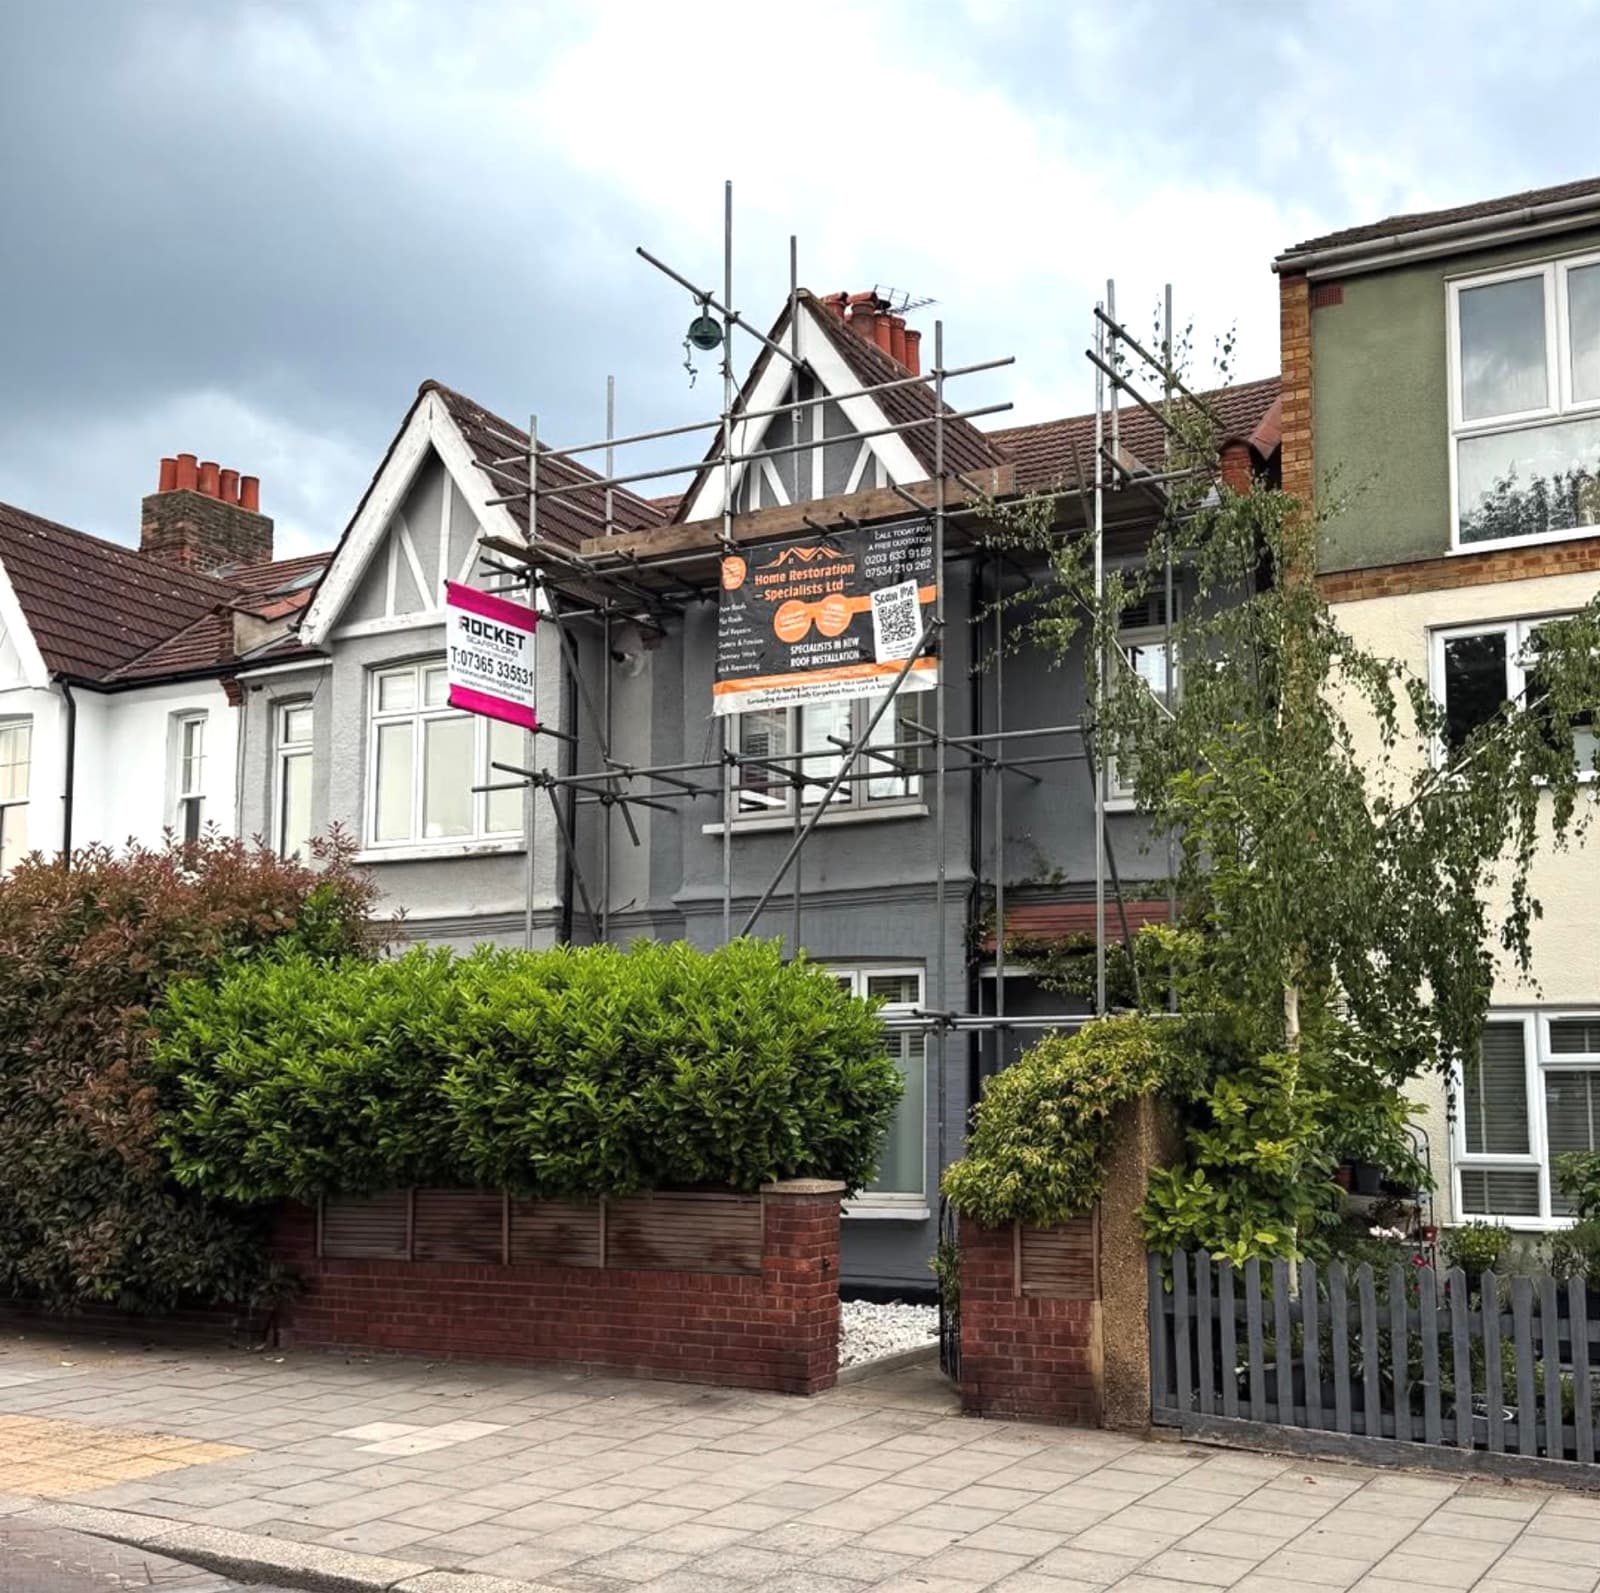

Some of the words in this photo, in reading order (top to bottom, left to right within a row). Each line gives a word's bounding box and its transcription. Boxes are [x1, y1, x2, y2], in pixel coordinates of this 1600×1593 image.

[893, 527, 915, 536] TODAY
[916, 525, 932, 533] FOR
[875, 541, 891, 549] FREE
[892, 535, 932, 547] QUOTATION
[864, 553, 887, 565] 0203
[754, 572, 786, 586] Home
[789, 563, 855, 581] Restoration
[866, 566, 892, 578] 07534
[895, 563, 912, 573] 210
[764, 583, 823, 602] Specialists
[826, 578, 844, 592] Ltd
[874, 591, 898, 606] Scan
[459, 615, 526, 650] ROCKET
[466, 634, 519, 658] SCAFFOLDING
[790, 641, 832, 655] SPECIALISTS
[833, 641, 841, 649] IN
[843, 637, 859, 648] NEW
[450, 646, 494, 675] T:07365
[497, 661, 533, 687] 335531
[790, 657, 810, 668] ROOF
[811, 650, 859, 665] INSTALLATION
